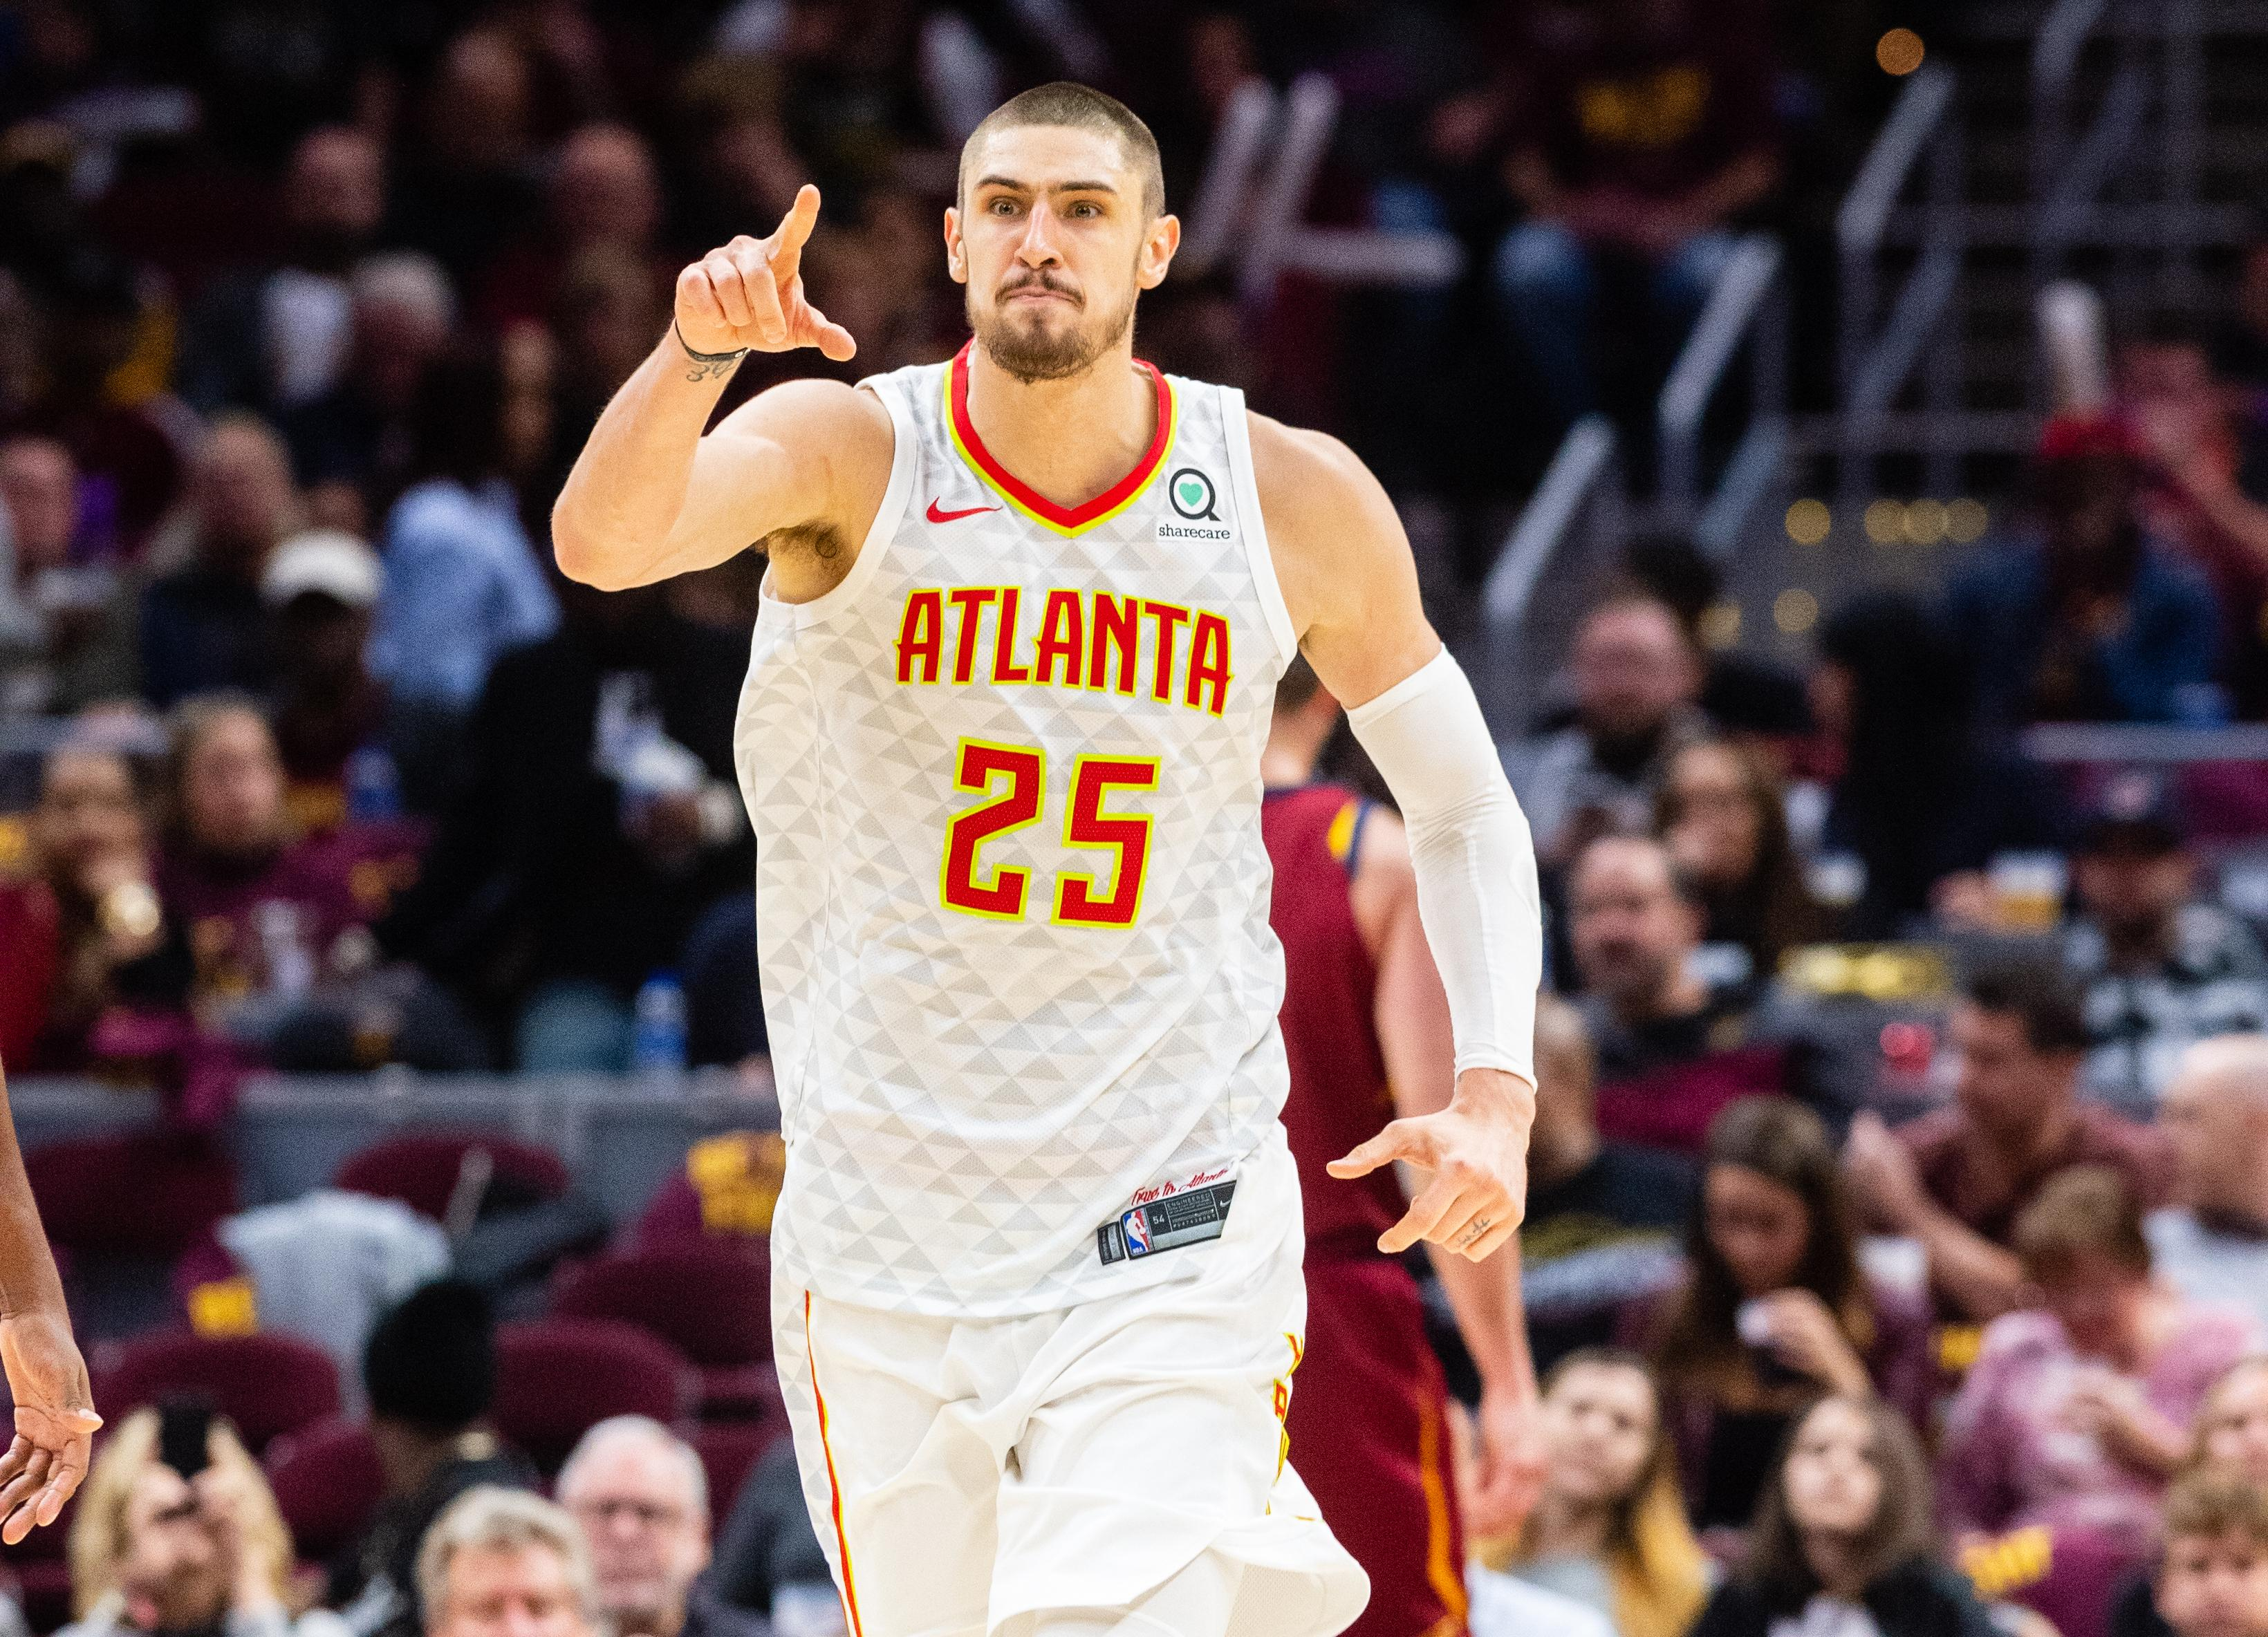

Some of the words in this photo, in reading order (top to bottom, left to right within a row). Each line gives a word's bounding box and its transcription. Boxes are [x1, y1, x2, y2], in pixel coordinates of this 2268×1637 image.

[1159, 523, 1230, 539] sharecare
[893, 586, 1235, 719] ATLANTA
[939, 736, 1162, 928] 25
[1152, 1214, 1165, 1225] 54
